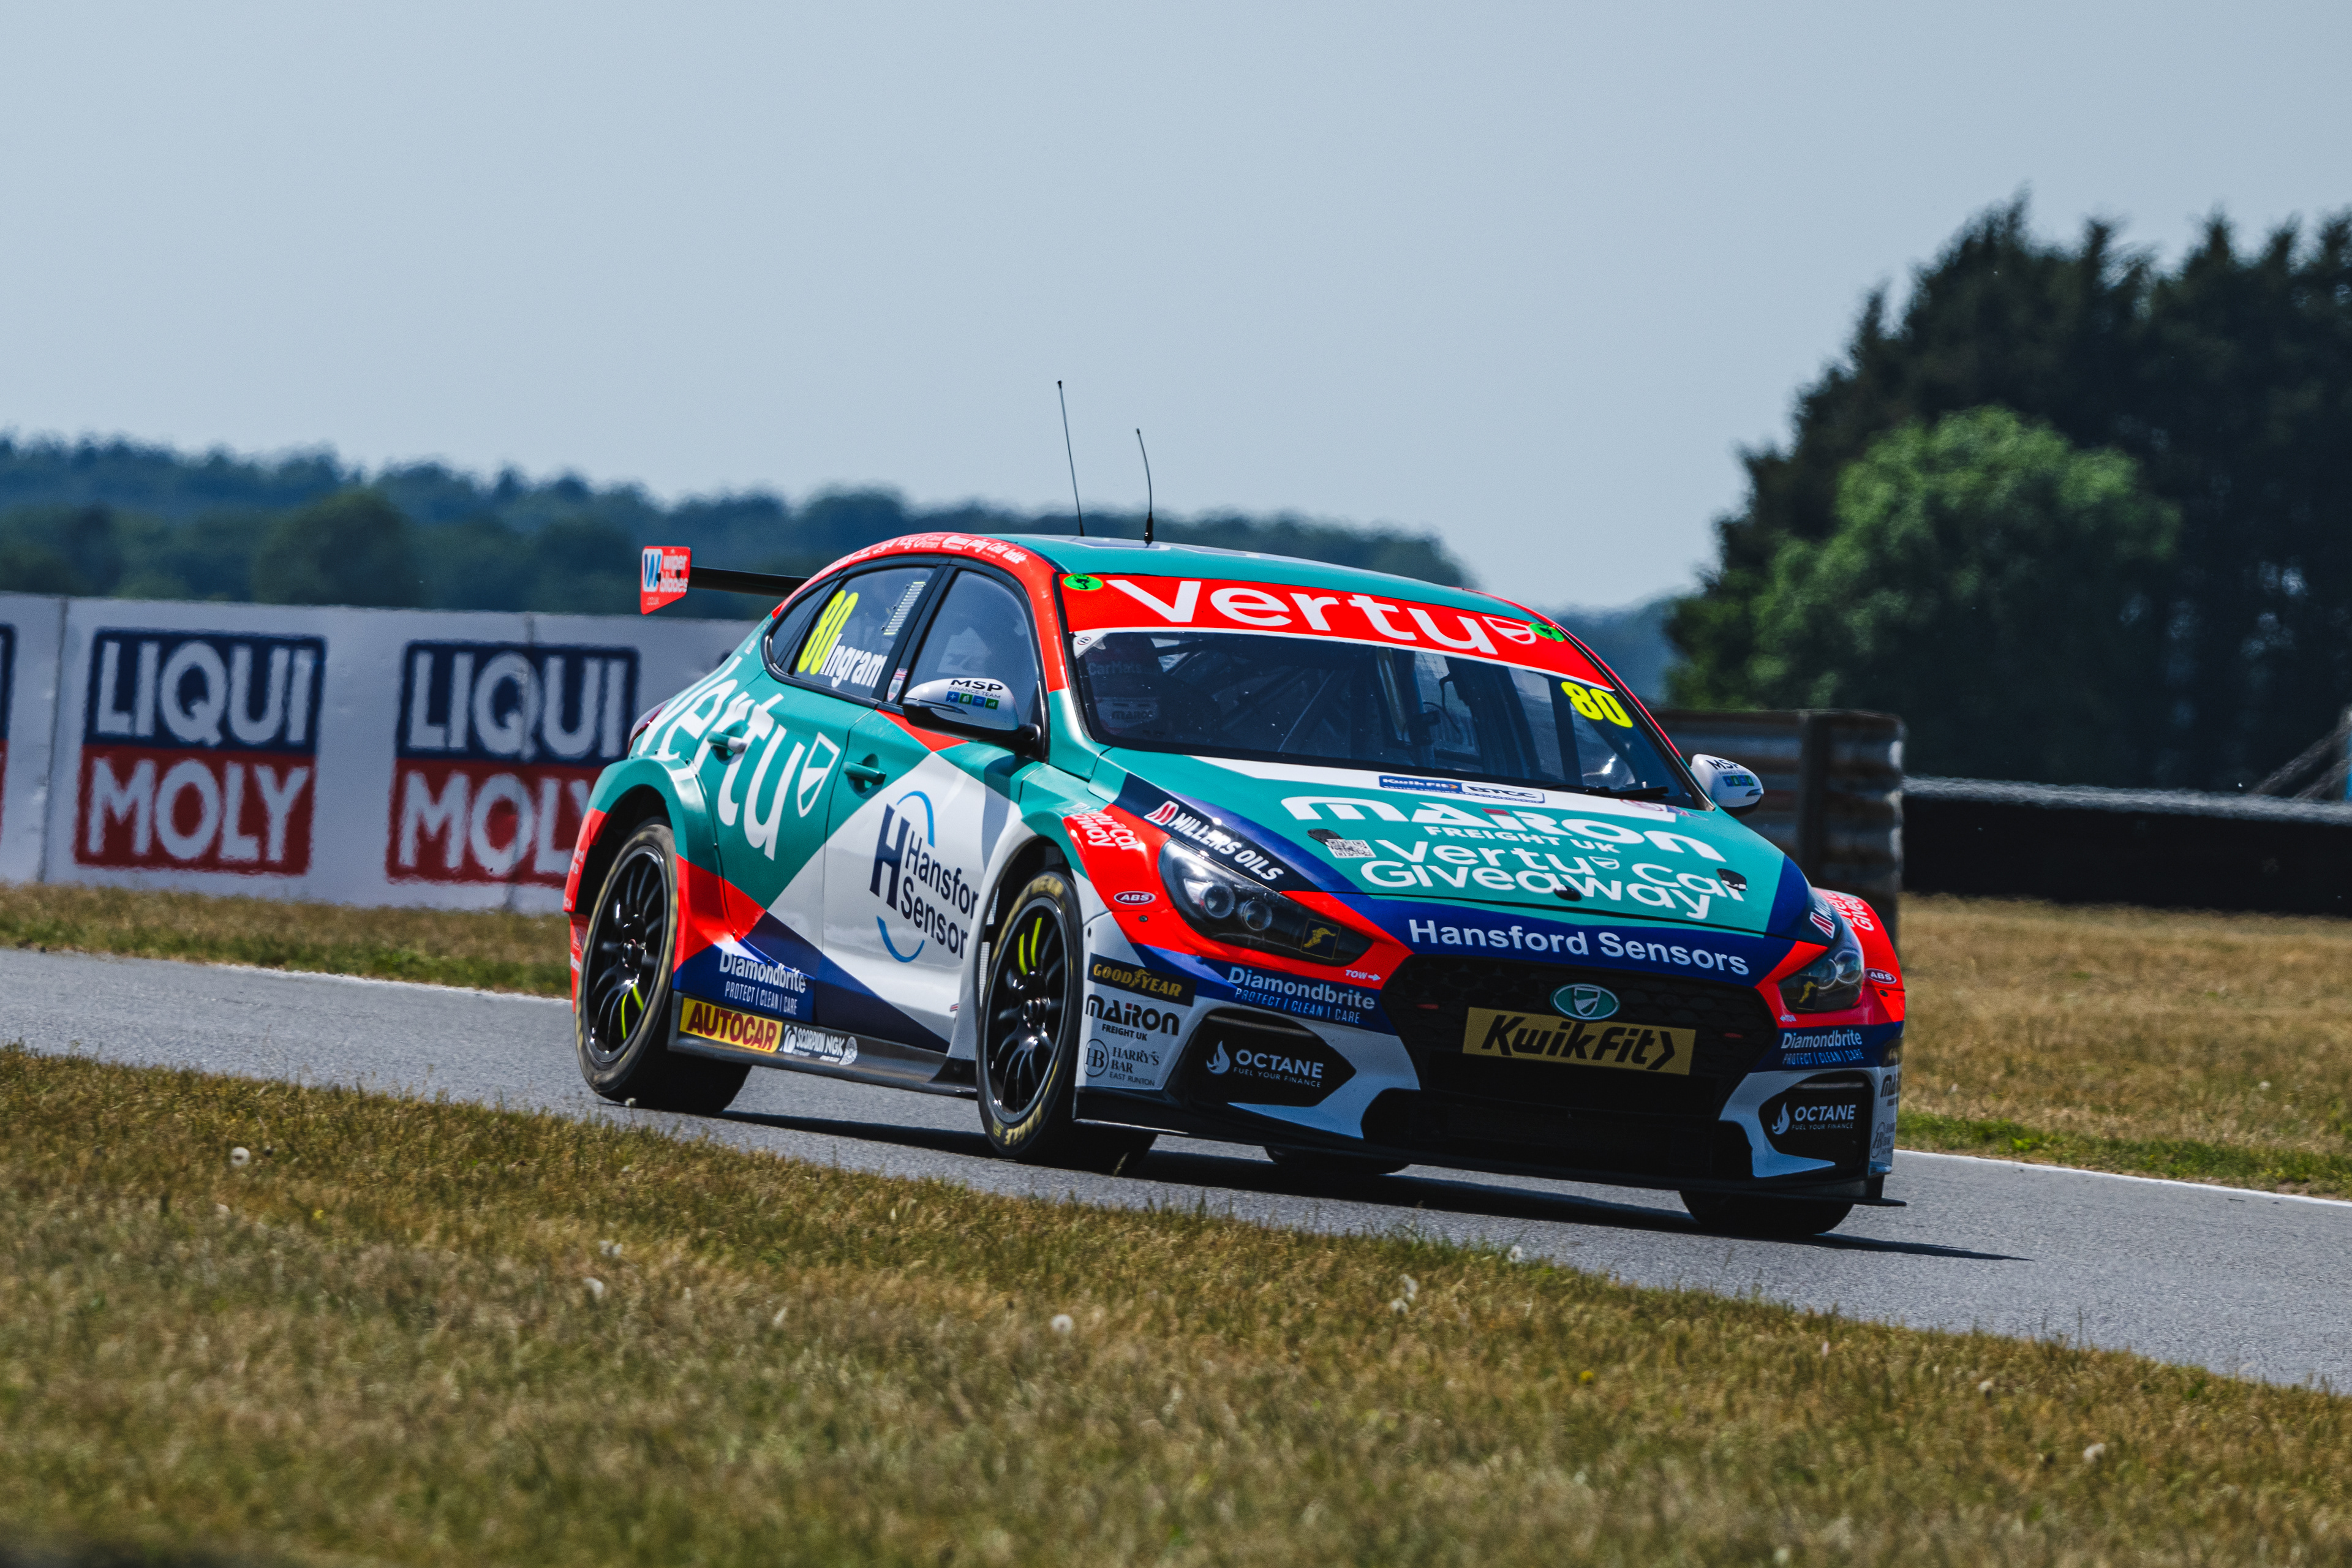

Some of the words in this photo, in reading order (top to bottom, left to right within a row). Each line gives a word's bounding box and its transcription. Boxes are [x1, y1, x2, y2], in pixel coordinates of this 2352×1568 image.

[797, 590, 859, 675] 80
[820, 633, 888, 687] Ingram
[97, 639, 316, 748] LIQUI
[949, 686, 979, 695] FINANCE
[951, 680, 1003, 692] MSP
[407, 649, 629, 763] LIQUI
[1561, 682, 1633, 728] 80
[1467, 786, 1537, 798] BTCC
[87, 756, 308, 862] MOLY
[1168, 813, 1242, 854] MILLERS
[1234, 850, 1284, 880] OILS
[1423, 826, 1560, 846] FREIGHT
[1570, 839, 1621, 854] UK
[905, 830, 979, 919] Hansfor
[1120, 892, 1151, 903] ABS
[900, 876, 969, 960] Sensor
[1409, 919, 1589, 956] Hansford
[1597, 932, 1750, 976] Sensors
[719, 950, 807, 993] Diamondbrite
[1346, 970, 1367, 979] TOW
[1870, 971, 1891, 981] ABS
[725, 981, 755, 1003] PROTECT
[760, 989, 779, 1010] CLEAN
[784, 998, 797, 1015] CARE
[1227, 967, 1376, 1010] Diamondbrite
[1235, 987, 1281, 1008] PROTECT
[1291, 1000, 1324, 1017] CLEAN
[1335, 1009, 1360, 1024] CARE
[686, 1002, 777, 1050] AUTOCAR
[1102, 1023, 1135, 1039] FREIGHT
[1136, 1031, 1148, 1041] UK
[1781, 1029, 1863, 1049] Diamondbrite
[824, 1035, 845, 1057] NGK
[1782, 1052, 1812, 1065] PROTECT
[1820, 1051, 1841, 1065] CLEAN
[1847, 1049, 1864, 1061] CARE
[1111, 1060, 1133, 1073] BAR
[1234, 1066, 1253, 1076] FUEL
[1258, 1071, 1280, 1080] YOUR
[1284, 1075, 1321, 1088] FINANCE
[1236, 1049, 1324, 1079] OCTANE
[1110, 1072, 1126, 1080] EAST
[1128, 1075, 1155, 1087] RUNTON
[1794, 1104, 1856, 1121] OCTANE
